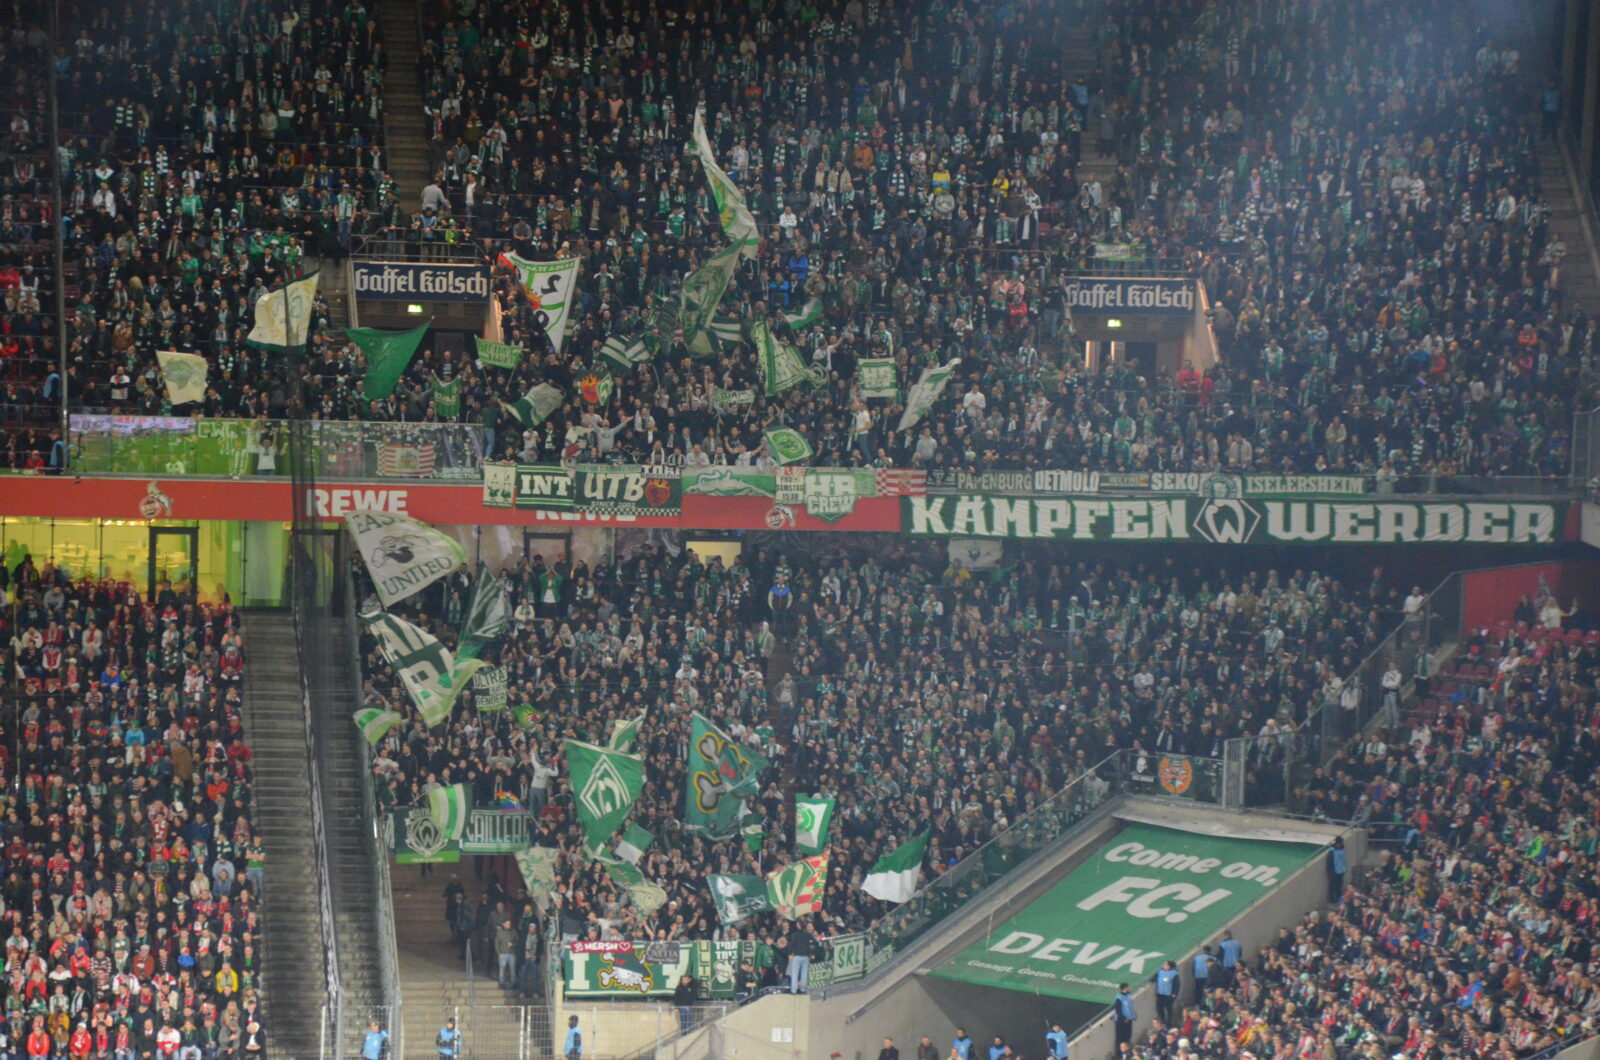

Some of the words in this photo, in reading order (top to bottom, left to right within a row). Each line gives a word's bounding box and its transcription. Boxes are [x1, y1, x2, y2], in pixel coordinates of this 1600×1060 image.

[354, 265, 416, 293] Gaffel
[419, 266, 488, 297] Kölsch
[1065, 282, 1125, 309] Gaffel
[1127, 284, 1195, 311] Kölsch
[520, 474, 572, 496] INT
[583, 472, 647, 502] UTB
[1034, 470, 1100, 493] DETMOLD
[1247, 475, 1364, 494] ISELERSHEIM
[306, 489, 408, 517] REWE
[806, 495, 855, 514] CREW
[910, 495, 1190, 539] KÄMPFEN
[1265, 502, 1556, 543] WERDER
[381, 556, 453, 596] UNITED
[1104, 842, 1222, 874] Come
[1219, 861, 1281, 887] on,
[1076, 876, 1232, 924] FC!
[584, 942, 618, 951] HERSH
[837, 944, 861, 969] SRL
[989, 931, 1166, 975] DEVK
